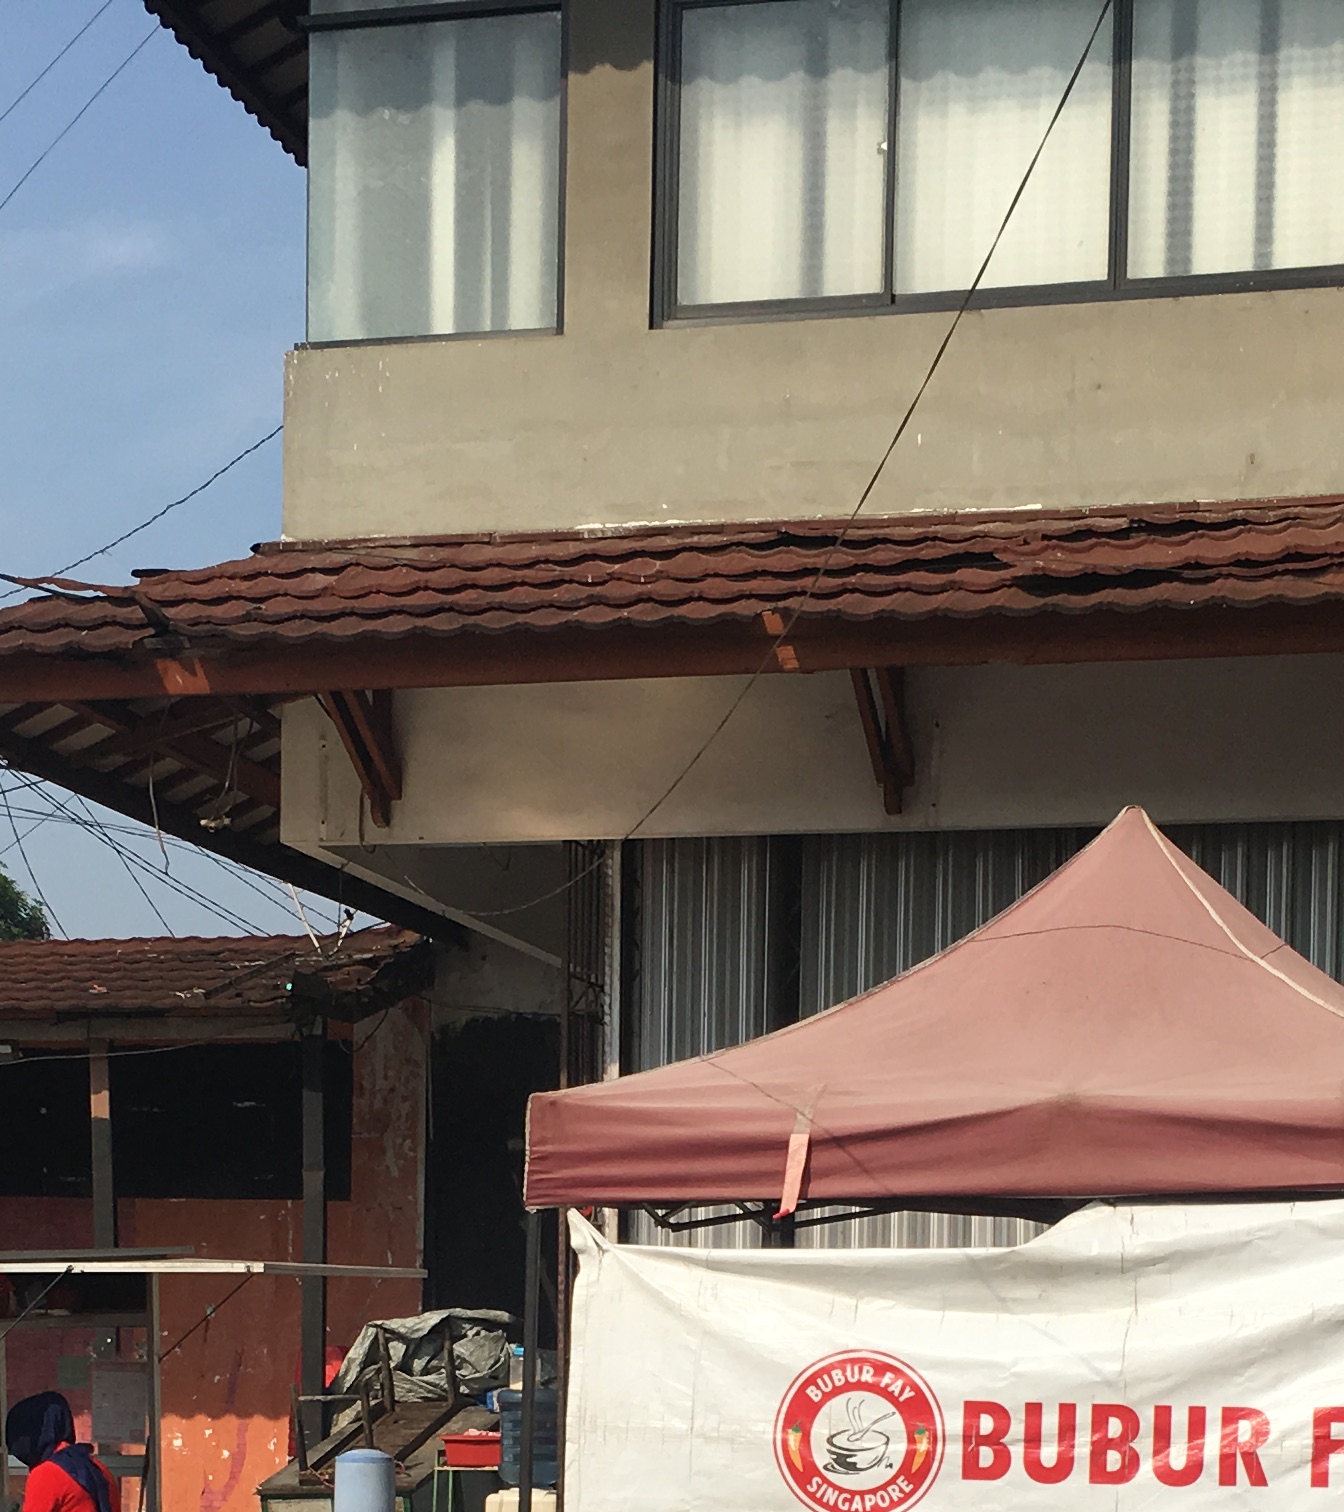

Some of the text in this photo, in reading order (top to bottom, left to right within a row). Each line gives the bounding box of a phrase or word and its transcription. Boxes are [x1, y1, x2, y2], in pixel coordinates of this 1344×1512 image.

[805, 1364, 916, 1403] BUBUR FAY
[961, 1400, 1269, 1488] BUBUR
[806, 1475, 914, 1512] SINGAPORE
